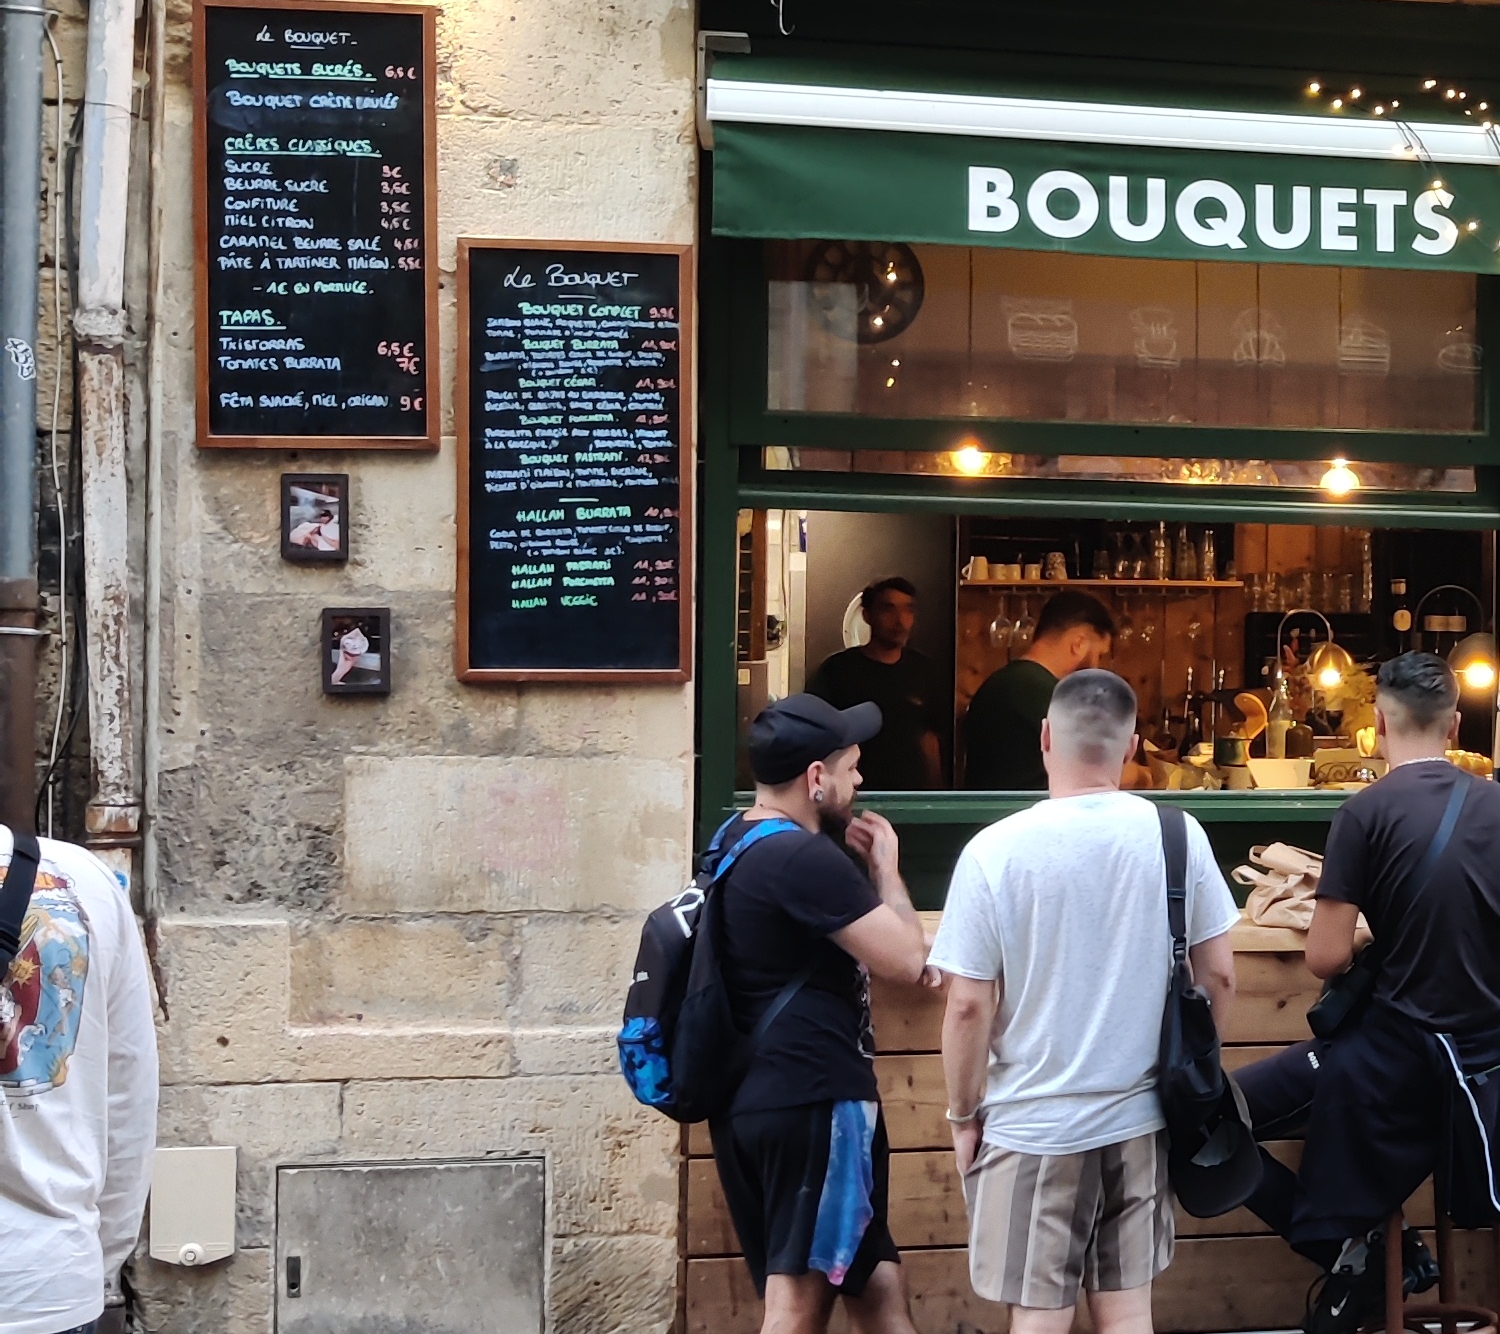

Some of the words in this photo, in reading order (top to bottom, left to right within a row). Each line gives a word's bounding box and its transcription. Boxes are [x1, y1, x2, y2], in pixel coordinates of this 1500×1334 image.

[225, 58, 302, 76] BOUQUETS
[225, 91, 303, 110] BOUQUET
[223, 179, 282, 192] BEURRE
[284, 179, 329, 193] SUCRE
[224, 197, 299, 212] CONFITURE
[967, 165, 1459, 256] BOUQUETS
[224, 215, 257, 227] MIEL
[261, 216, 314, 229] CITRON
[219, 235, 287, 250] CARAMEL
[292, 236, 342, 251] BEURRE
[275, 255, 341, 270] TARTINER
[503, 266, 536, 288] Le
[545, 264, 640, 289] BOUQUET
[517, 302, 584, 319] BOUQUET
[522, 339, 565, 351] BOUQUET
[570, 339, 619, 350] BURRATA
[218, 356, 279, 371] TOMATES
[283, 357, 341, 371] BURRATA
[518, 378, 561, 389] BOUQUET
[519, 415, 563, 425] BOUQUET
[519, 453, 569, 465] BOUQUET
[575, 505, 632, 519] BURRATA
